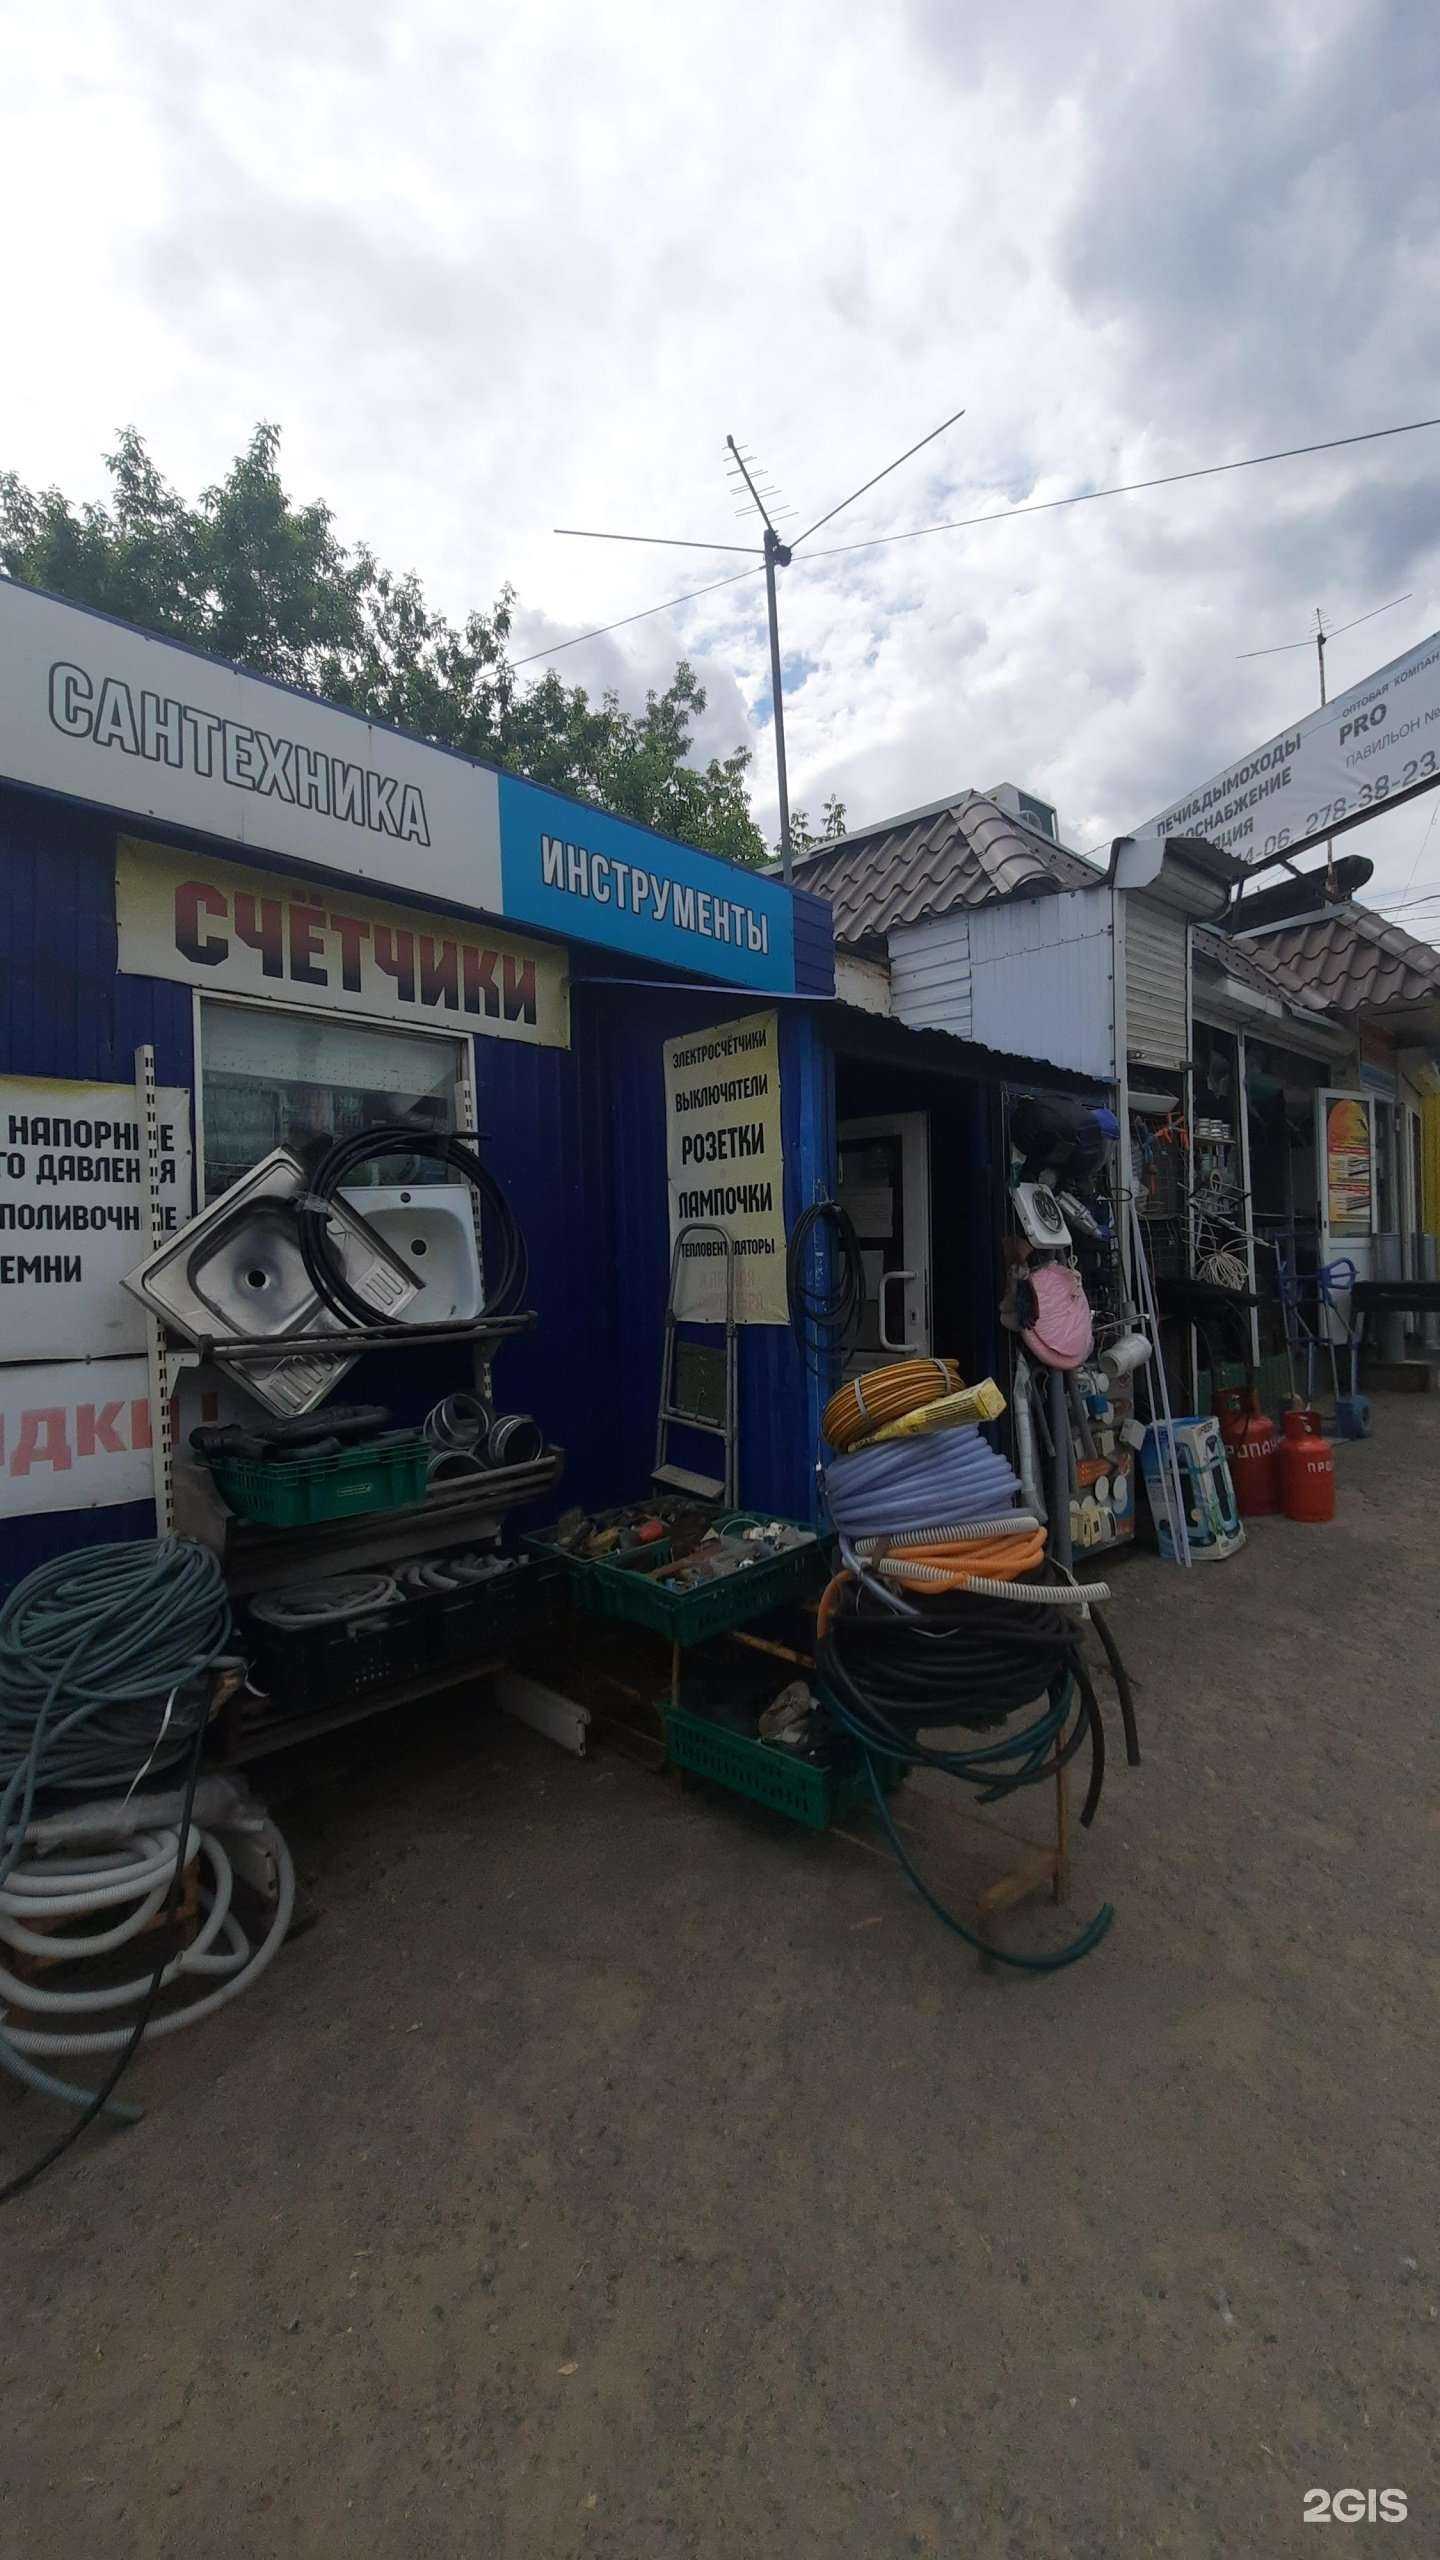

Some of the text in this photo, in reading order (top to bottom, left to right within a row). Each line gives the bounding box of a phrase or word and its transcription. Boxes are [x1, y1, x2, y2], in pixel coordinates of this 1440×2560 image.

[1340, 703, 1386, 746] PRO
[1345, 717, 1420, 769] ПАВИЛЬОН
[49, 661, 430, 846] САНТЕХНИКА
[541, 833, 769, 955] ИНСТРУМЕНТЫ
[174, 880, 536, 1025] СЧЁТЧИКИ
[673, 1029, 767, 1069] ЭЛЕКТРОСЧЁТЧИКИ
[675, 1074, 768, 1113] ВЫКЛЮЧАТЕЛИ
[682, 1122, 765, 1165] РОЗЕТКИ
[36, 1154, 176, 1186] ДАВЛЕНЯ
[0, 1203, 177, 1231] ПОЛИВОЧНЕ
[678, 1182, 772, 1219] ЛАМПОЧКИ
[681, 1237, 775, 1258] ТЕПЛОВЕНТЛЯТОРЫ
